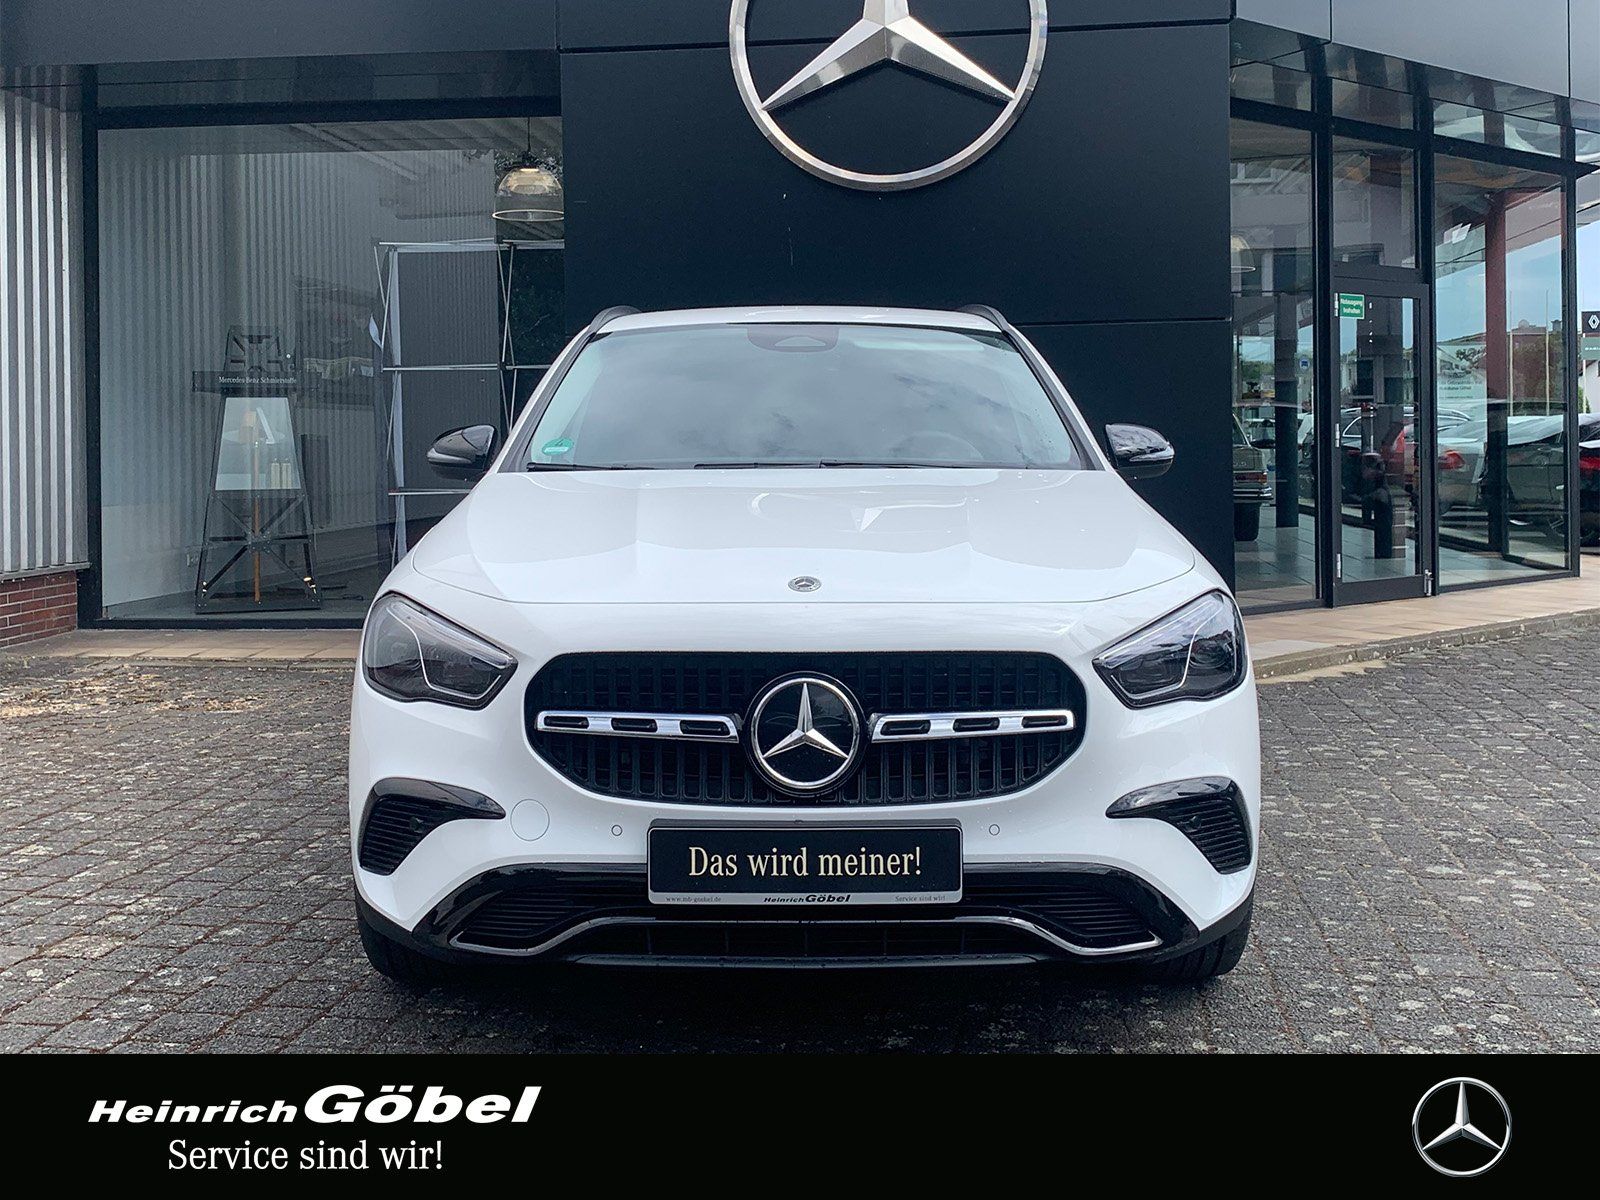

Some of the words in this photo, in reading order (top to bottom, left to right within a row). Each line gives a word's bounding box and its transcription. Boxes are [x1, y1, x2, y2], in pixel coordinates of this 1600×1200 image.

[688, 846, 738, 877] Das
[747, 846, 809, 877] wird
[818, 846, 922, 877] meiner!
[805, 893, 851, 904] Göbel
